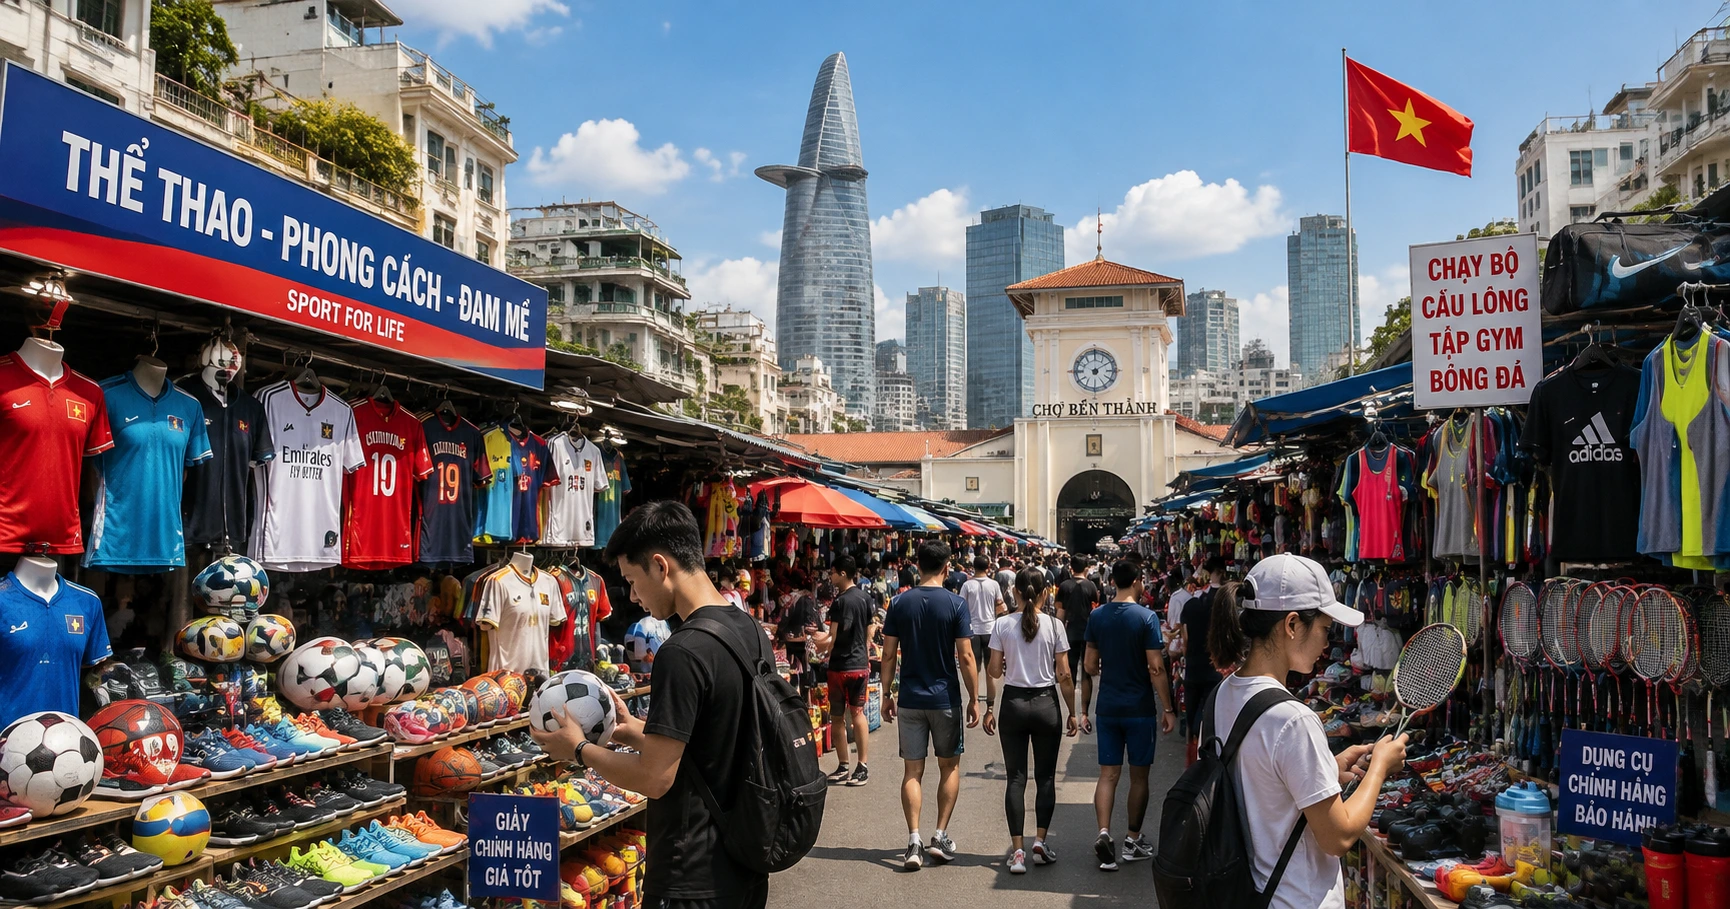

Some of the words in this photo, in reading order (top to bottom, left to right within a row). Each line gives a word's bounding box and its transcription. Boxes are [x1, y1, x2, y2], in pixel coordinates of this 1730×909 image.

[62, 130, 150, 214] THỂ
[158, 167, 253, 247] THAO
[281, 214, 375, 289] PHONG
[458, 283, 500, 333] ĐAM
[1428, 254, 1483, 284] CHẠY
[1490, 245, 1519, 280] BỘ
[287, 288, 341, 324] SPORT
[344, 306, 373, 334] FOR
[376, 315, 405, 343] LIFE
[1471, 285, 1529, 316] LÔNG
[1429, 325, 1470, 361] TẬP
[1476, 326, 1524, 352] GYM
[282, 444, 332, 467] Emirates
[1568, 443, 1624, 464] adidas
[437, 461, 460, 504] 19
[1582, 746, 1626, 771] DỤNG
[1630, 751, 1654, 776] CỤ
